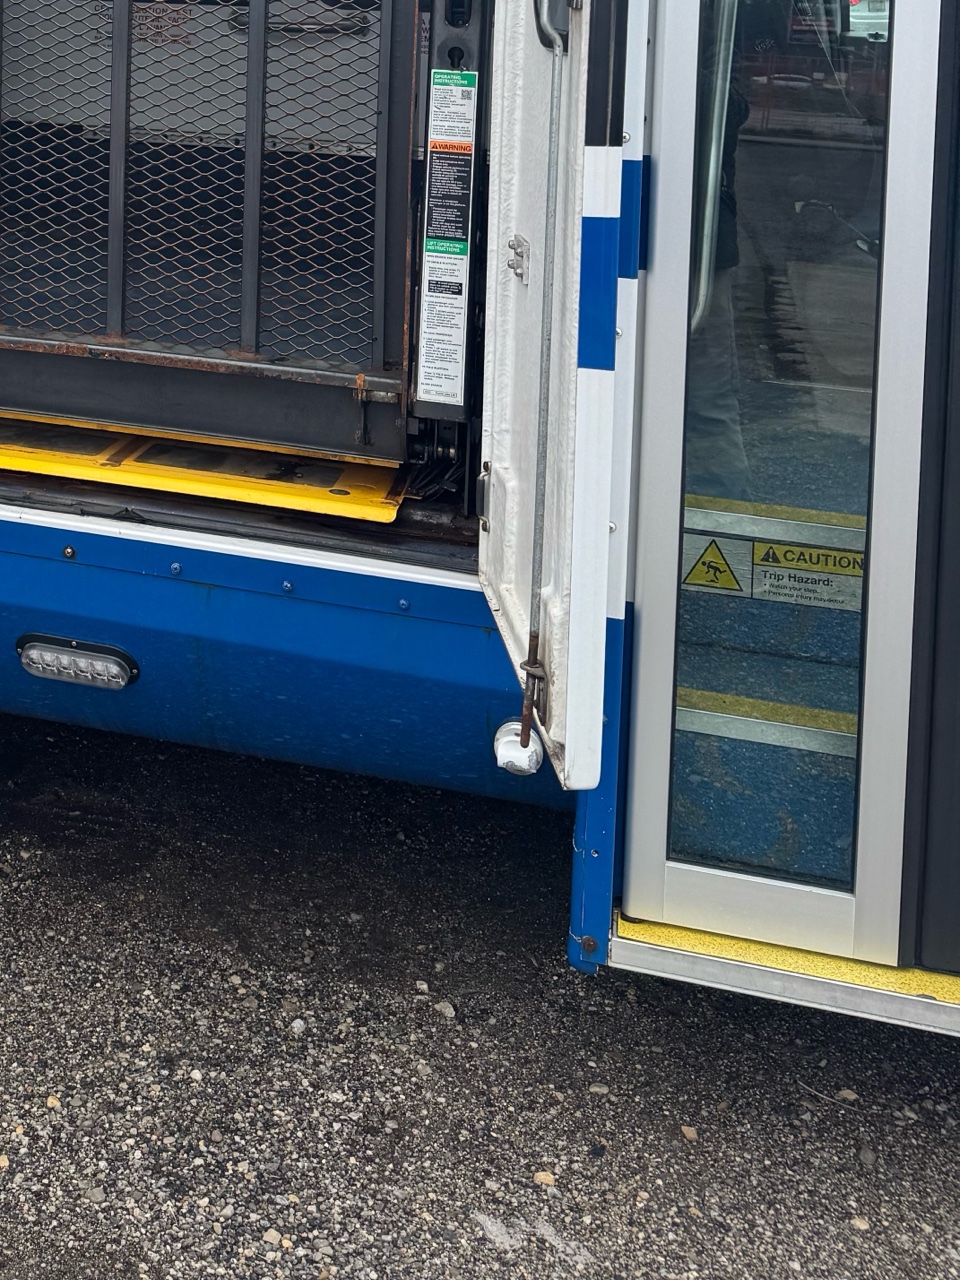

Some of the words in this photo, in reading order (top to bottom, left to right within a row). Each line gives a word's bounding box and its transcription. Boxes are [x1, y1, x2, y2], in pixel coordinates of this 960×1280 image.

[438, 143, 472, 152] WARNING
[783, 549, 864, 570] CAUTION
[761, 570, 784, 582] Trip
[788, 573, 834, 587] Hazard:
